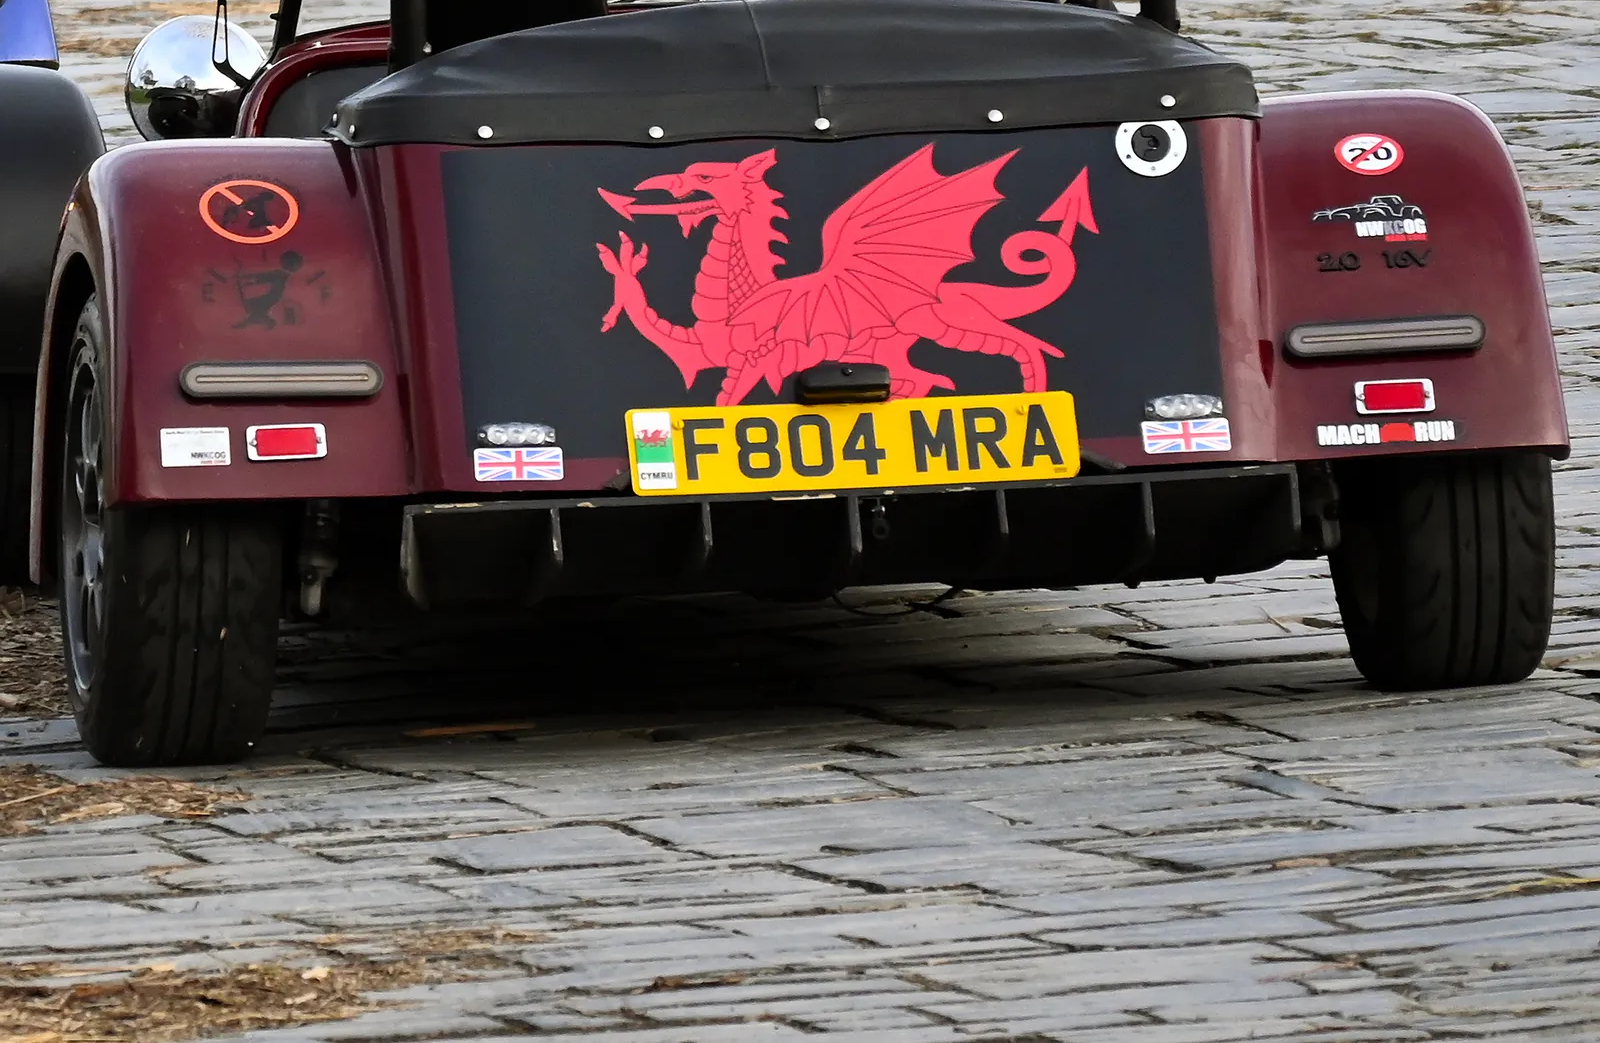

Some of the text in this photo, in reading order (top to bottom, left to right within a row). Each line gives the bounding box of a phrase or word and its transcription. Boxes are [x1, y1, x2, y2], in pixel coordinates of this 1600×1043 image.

[1348, 146, 1393, 162] 20
[1355, 218, 1427, 237] NWKCOG
[1381, 247, 1433, 269] 16V
[682, 404, 1064, 481] F804 MRA
[1317, 420, 1456, 446] MACH RUN
[640, 471, 673, 480] CYMRU
